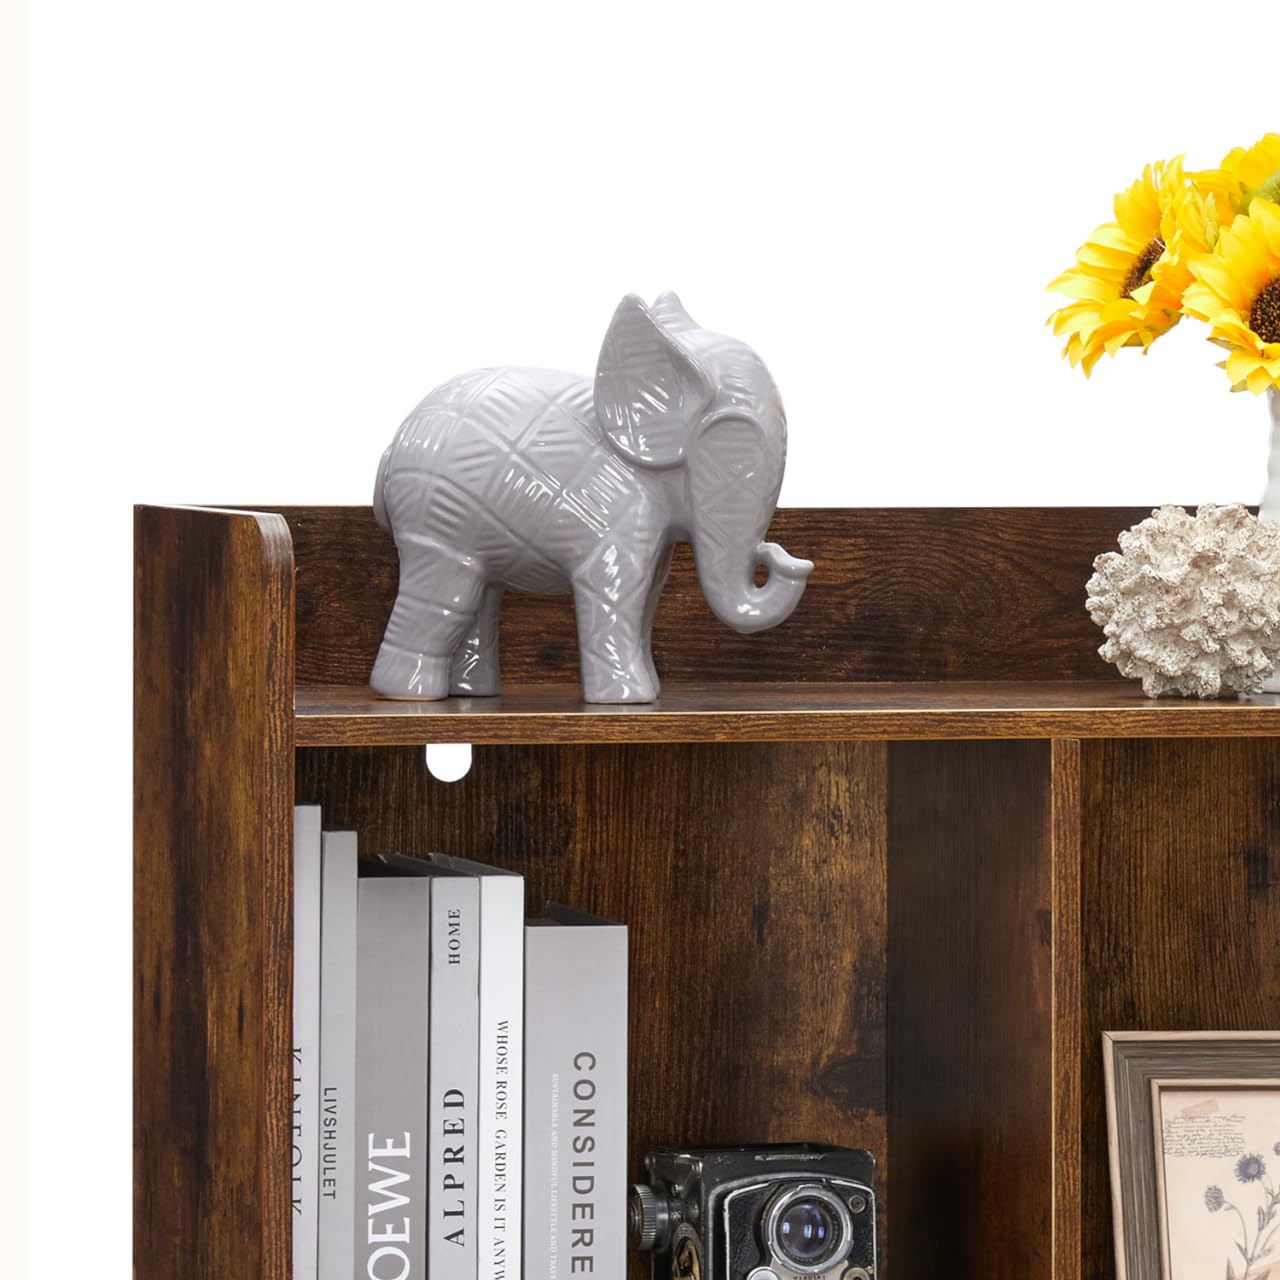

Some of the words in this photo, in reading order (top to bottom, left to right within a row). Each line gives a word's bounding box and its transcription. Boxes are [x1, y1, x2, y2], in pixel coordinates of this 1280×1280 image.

[448, 908, 461, 965] HOME
[496, 1019, 509, 1076] WHOSE
[496, 1080, 508, 1121] ROSE
[322, 1087, 337, 1199] LIVSHJULET
[443, 1088, 465, 1248] ALPRED
[494, 1129, 507, 1194] GARDEN
[494, 1198, 506, 1213] IS
[494, 1217, 506, 1232] IT
